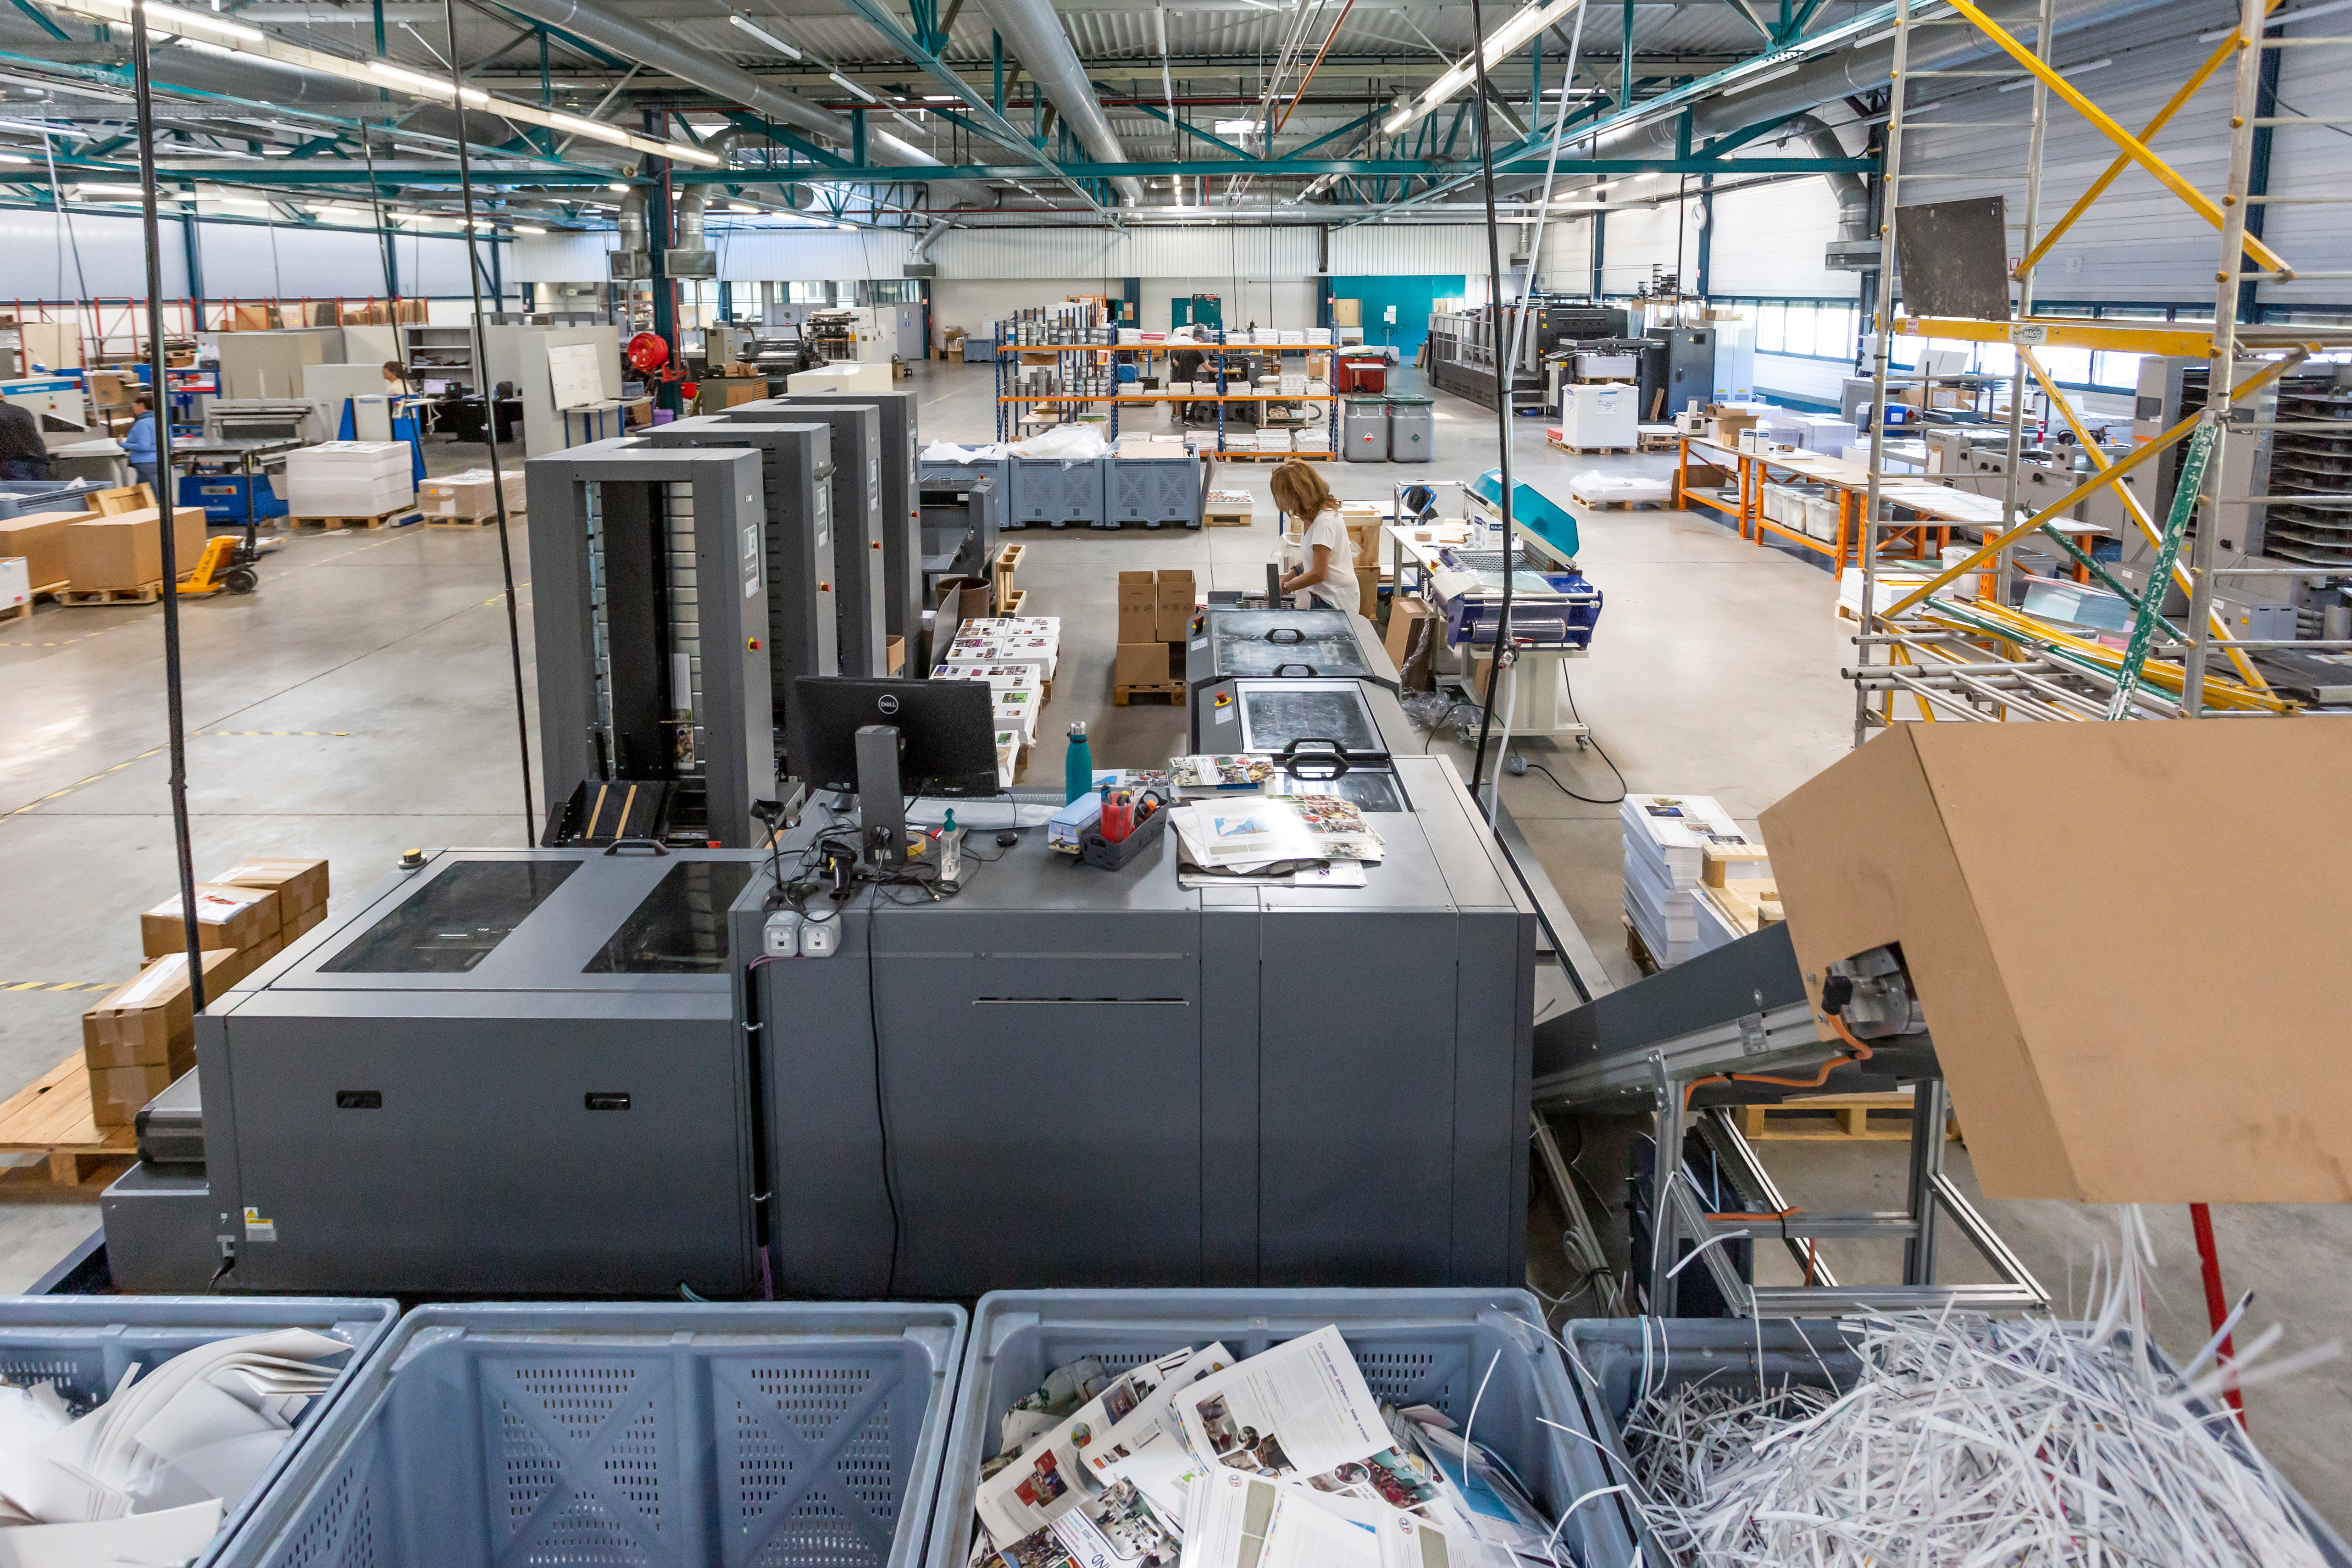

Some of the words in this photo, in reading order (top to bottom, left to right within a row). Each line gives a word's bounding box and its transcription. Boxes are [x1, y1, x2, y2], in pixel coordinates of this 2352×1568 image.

[201, 549, 215, 572] RAJA
[1328, 1364, 1338, 1377] pour
[1335, 1378, 1352, 1407] préparer
[1357, 1423, 1370, 1443] avenir
[1082, 1529, 1093, 1540] 2023
